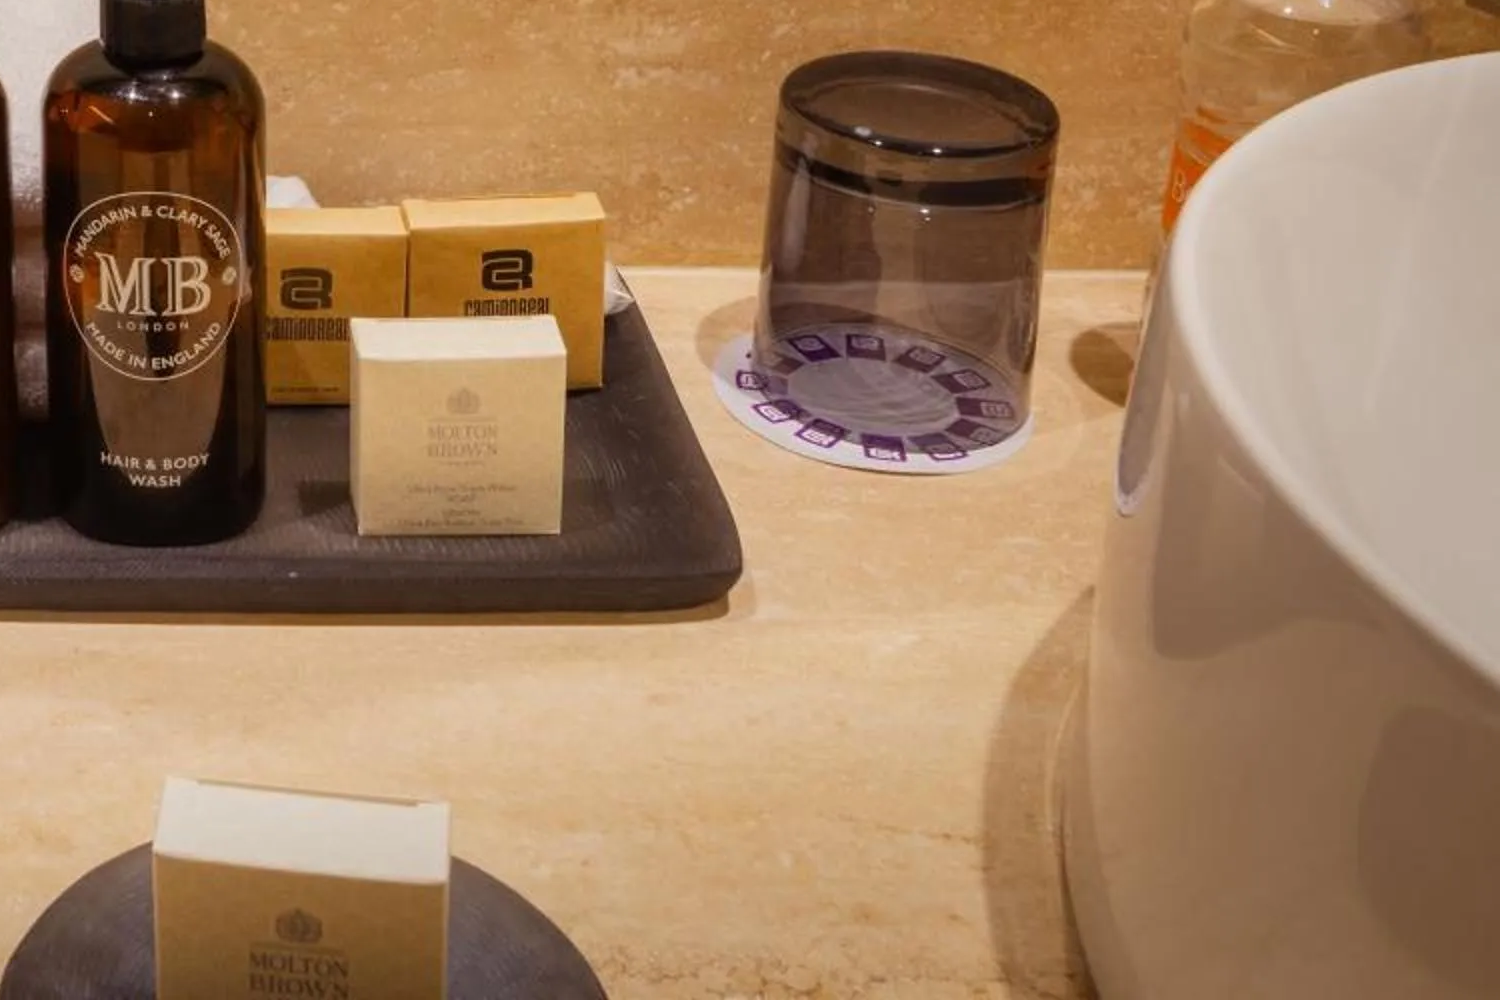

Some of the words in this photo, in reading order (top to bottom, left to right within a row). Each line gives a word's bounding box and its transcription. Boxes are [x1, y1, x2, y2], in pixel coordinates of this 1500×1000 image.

[75, 205, 137, 258] MANDARIN
[140, 204, 153, 218] &
[157, 205, 208, 231] CLARY
[203, 222, 233, 260] SAGE
[94, 251, 212, 317] MB
[116, 321, 190, 333] LONDON
[85, 321, 125, 361] MADE
[128, 353, 147, 370] IN
[151, 321, 222, 371] ENGLAND
[427, 424, 498, 441] MOLTON
[100, 451, 141, 470] HAIR
[145, 458, 157, 471] &
[162, 453, 210, 470] BODY
[129, 474, 182, 488] WASH
[250, 951, 350, 978] MOLTON
[250, 973, 350, 1000] BROWN
